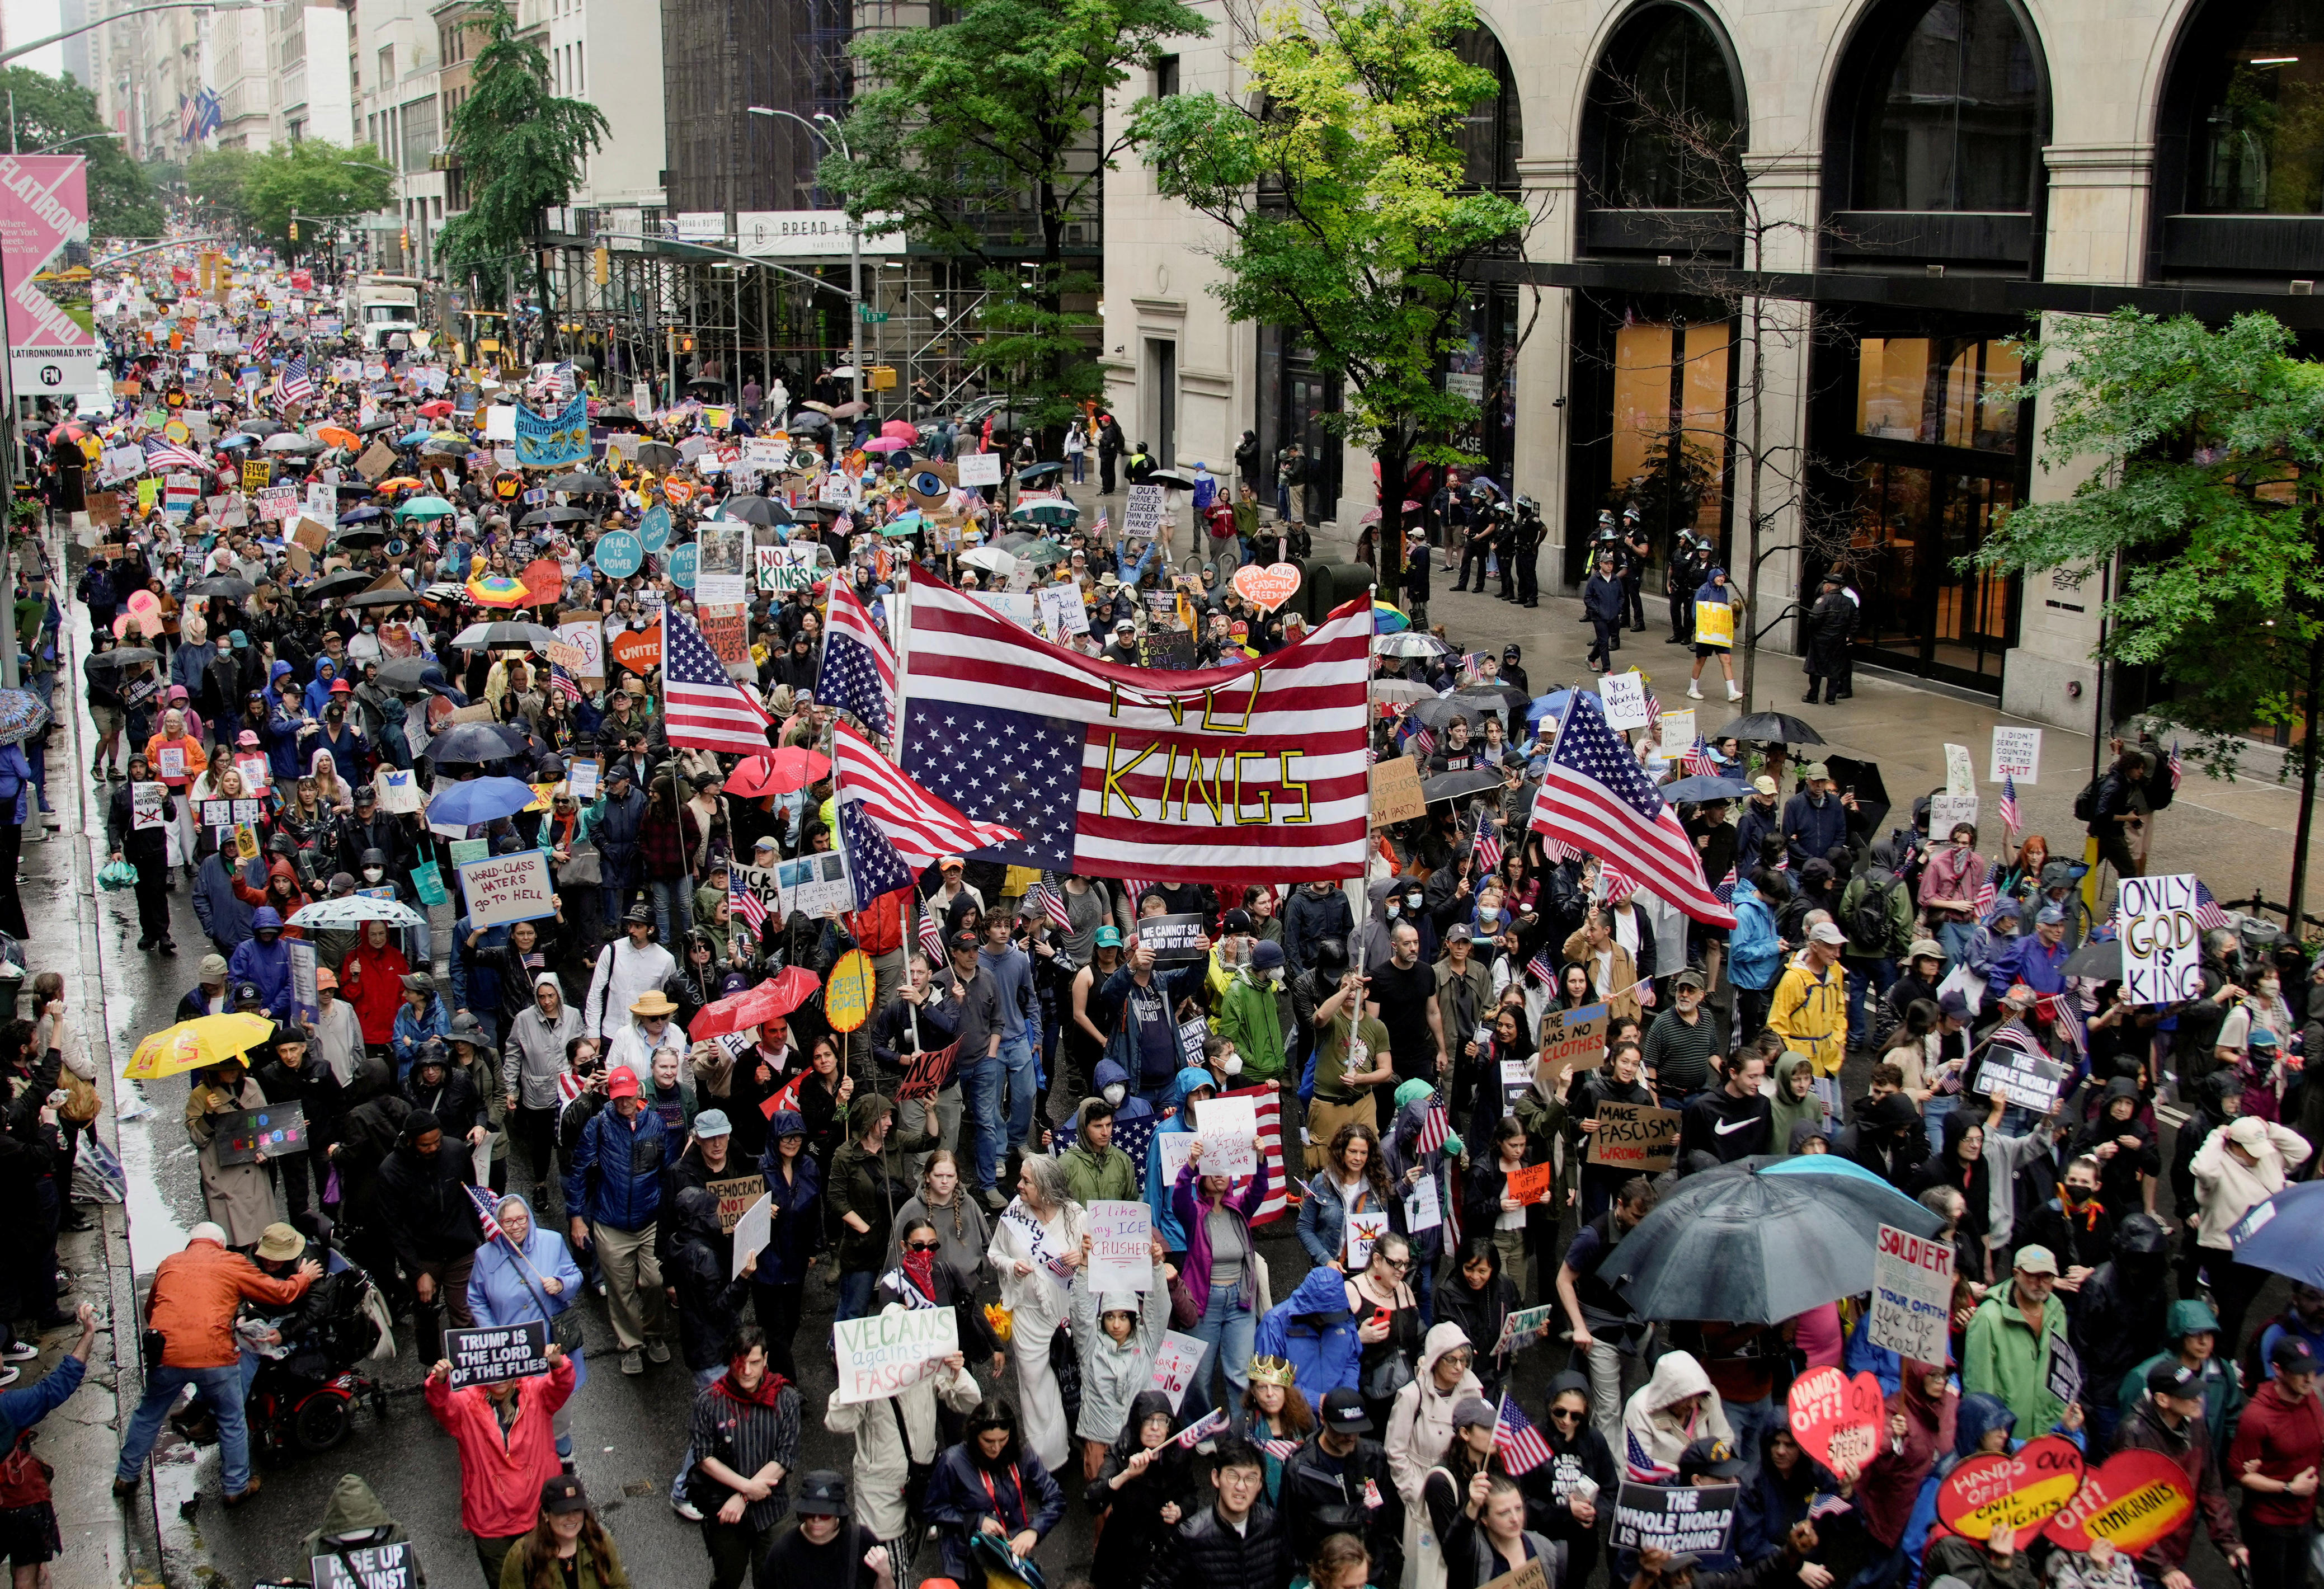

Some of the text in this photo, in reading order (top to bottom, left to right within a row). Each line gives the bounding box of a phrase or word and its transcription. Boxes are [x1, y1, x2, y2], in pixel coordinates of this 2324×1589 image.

[0, 157, 86, 236] FLATIRON
[703, 219, 725, 227] BUTTER
[783, 222, 825, 236] BREAD
[11, 285, 82, 345] NOMAD
[871, 313, 878, 322] 31
[10, 349, 92, 358] LATIRONNOMAD.NYC
[43, 369, 59, 383] FN
[518, 411, 584, 435] BILLIONAIRES
[245, 462, 269, 471] STOP
[257, 487, 295, 500] NOBODY
[319, 487, 329, 496] NO
[1136, 486, 1158, 495] OUR
[274, 497, 297, 508] ABOVE
[1128, 494, 1152, 504] PARADE
[280, 508, 298, 519] LAW
[1130, 502, 1156, 513] BIGGER
[645, 509, 662, 525] PEACE
[1127, 519, 1158, 529] PARADE!
[605, 537, 631, 548] PEACE
[647, 527, 665, 542] POWER
[614, 549, 622, 557] IS
[761, 551, 783, 567] NO
[604, 558, 632, 570] POWER
[685, 561, 693, 570] IS
[1272, 566, 1293, 577] OUR
[760, 567, 810, 590] KINGS
[1236, 566, 1258, 579] HANDS
[1245, 579, 1295, 591] ACADEMIC
[2052, 582, 2080, 593] FIFTH
[1041, 592, 1061, 603] Liberty
[1249, 590, 1291, 601] FREEDOM
[717, 616, 745, 627] KINGS
[1235, 624, 1246, 632] OUR
[1138, 634, 1189, 648] FASCIST
[551, 646, 582, 663] STAND
[619, 643, 659, 660] UNITE
[562, 659, 577, 667] UP
[135, 680, 158, 698] URGENCY
[1614, 704, 1644, 717] US!!
[1664, 716, 1691, 726] Defend
[1996, 739, 2018, 748] SERVE
[1996, 748, 2031, 757] COUNTRY
[1998, 764, 2031, 775] SHIT
[1102, 732, 1311, 826] KINGS
[1390, 803, 1418, 816] PARTY
[1933, 797, 1975, 808] God Forbid
[468, 861, 535, 883] WORLD-CLASS
[481, 875, 526, 894] HATERS
[812, 883, 835, 894] HAVE
[514, 889, 543, 901] HELL
[2123, 875, 2194, 918] ONLY
[1142, 923, 1201, 939] WE CANNOT SAY
[2127, 911, 2196, 959] GOD
[1154, 937, 1183, 949] DID NOT
[832, 972, 868, 995] PEOPLE
[2127, 962, 2203, 1004] KING
[831, 992, 864, 1013] POWER
[1543, 1013, 1563, 1030] THE
[1544, 1023, 1591, 1048] HAS NO
[1542, 1034, 1603, 1063] CLOTHES
[2011, 1052, 2035, 1072] THE
[1981, 1061, 2059, 1095] WHOLE WORLD
[1979, 1076, 2051, 1109] IS WATCHING
[248, 1113, 269, 1129] NO
[1600, 1106, 1639, 1121] MAKE
[1202, 1126, 1225, 1140] HAD
[1599, 1118, 1677, 1144] FASCISM
[1216, 1137, 1245, 1150] KING
[1229, 1155, 1249, 1165] WAR
[1599, 1145, 1645, 1161] WRONG
[1514, 1165, 1544, 1179] HANDS
[708, 1179, 763, 1197] DEMOCRACY
[1520, 1176, 1538, 1187] OFF
[721, 1197, 746, 1214] NOT
[1108, 1204, 1137, 1217] like
[1002, 1205, 1044, 1241] Liberty
[1094, 1220, 1147, 1238] my ICE
[1091, 1240, 1152, 1256] CRUSHED
[1878, 1226, 1951, 1276] SOLDIER
[1883, 1271, 1939, 1303] FORGET
[1876, 1286, 1947, 1321] YOUR OATH
[1907, 1311, 1934, 1336] the
[459, 1329, 528, 1351] TRUMP IS
[1869, 1319, 1932, 1361] People
[457, 1344, 531, 1366] THE LORD
[852, 1342, 935, 1373] against
[451, 1357, 548, 1383] OF THE FLIES
[1791, 1367, 1841, 1410] HANDS
[1792, 1385, 1879, 1431] OFF! OUR
[1833, 1419, 1861, 1440] FREE
[1828, 1435, 1869, 1459] SPEECH
[1953, 1450, 2078, 1496] HANDS OUR
[1967, 1479, 2013, 1505] OFF!
[1665, 1490, 1700, 1512] THE
[1975, 1494, 2023, 1520] CIVIL
[1989, 1497, 2067, 1529] RIGHTS
[2090, 1483, 2175, 1538] IMMIGRANTS
[1617, 1505, 1733, 1534] WHOLE WORLD
[1619, 1526, 1721, 1552] IS WATCHING
[379, 1545, 404, 1568] UP
